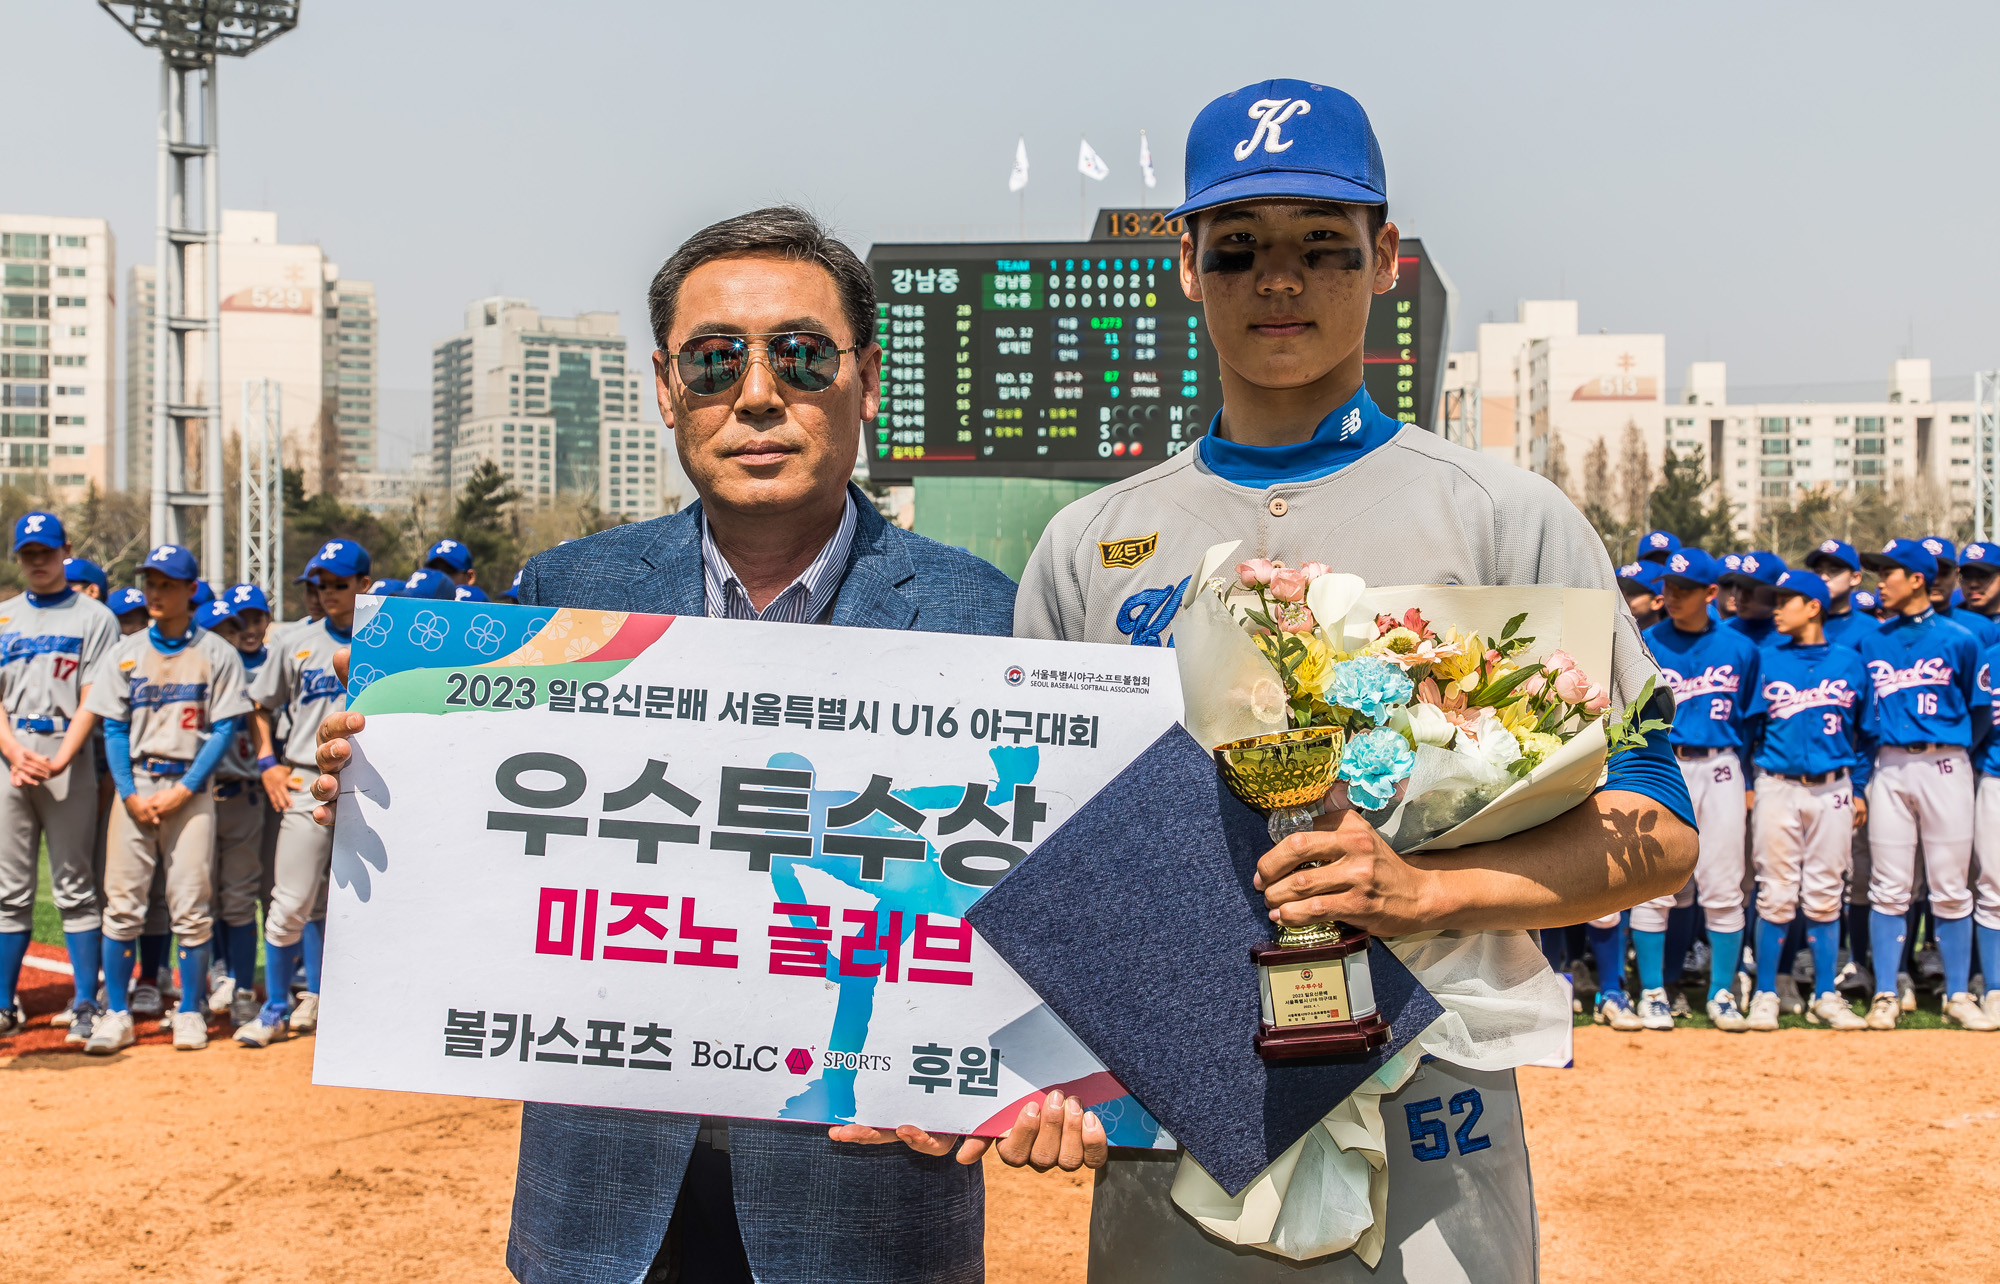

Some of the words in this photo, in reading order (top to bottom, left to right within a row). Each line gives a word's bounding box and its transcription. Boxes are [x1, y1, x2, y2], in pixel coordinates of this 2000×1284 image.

[1234, 97, 1311, 161] K
[1110, 213, 1183, 236] 13:20
[996, 260, 1030, 272] TEAM
[1050, 258, 1057, 271] 1
[1065, 258, 1074, 271] 2
[1081, 258, 1091, 271] 3
[1097, 258, 1107, 271] 4
[1114, 258, 1123, 271] 5
[1130, 258, 1139, 271] 6
[1147, 258, 1155, 271] 7
[1162, 258, 1172, 271] 8
[891, 268, 960, 294] 강남중
[1049, 274, 1060, 289] 0
[1065, 274, 1076, 289] 2
[1081, 274, 1092, 289] 0
[1097, 274, 1108, 289] 0
[1113, 274, 1124, 289] 0
[1129, 274, 1140, 289] 2
[1146, 274, 1155, 289] 1
[252, 288, 300, 309] 529
[1049, 292, 1060, 308] 0
[1065, 292, 1076, 308] 0
[1081, 292, 1092, 308] 0
[1098, 292, 1107, 308] 1
[1113, 292, 1124, 308] 0
[1129, 292, 1140, 308] 0
[1145, 292, 1157, 308] 0
[1397, 301, 1411, 313] LF
[960, 336, 969, 347] P
[1397, 333, 1412, 345] SS
[1401, 348, 1410, 361] C
[1133, 371, 1158, 383] BALL
[1599, 377, 1637, 397] 513
[960, 414, 969, 426] C
[1100, 406, 1111, 423] B
[1170, 405, 1183, 422] H
[1099, 424, 1110, 440] S
[1171, 423, 1182, 439] E
[1098, 442, 1112, 458] O
[1108, 537, 1155, 559] ZETT
[53, 656, 78, 681] 17
[1031, 669, 1150, 687] 서울특별시야구소프트볼협회
[1030, 680, 1049, 688] SEOUL
[1050, 682, 1079, 690] BASEBALL
[1080, 684, 1109, 692] SOFTBALL
[1110, 686, 1150, 694] ASSOCIATION
[446, 672, 536, 710] 2023
[548, 680, 708, 721] 일요신문배
[718, 690, 880, 733] 서울특별시
[892, 703, 959, 739] U16
[970, 707, 1099, 749] 야구대회
[1917, 692, 1938, 715] 16
[1713, 766, 1732, 783] 29
[1936, 758, 1953, 775] 16
[1833, 795, 1849, 809] 34
[487, 751, 1047, 886] 우수투수상
[535, 886, 739, 969] 미즈노
[767, 902, 974, 986] 글러브
[443, 1008, 673, 1071] 볼카스포츠
[823, 1050, 892, 1071] SPORTS
[908, 1042, 1001, 1098] 후원
[1404, 1087, 1491, 1162] 52
